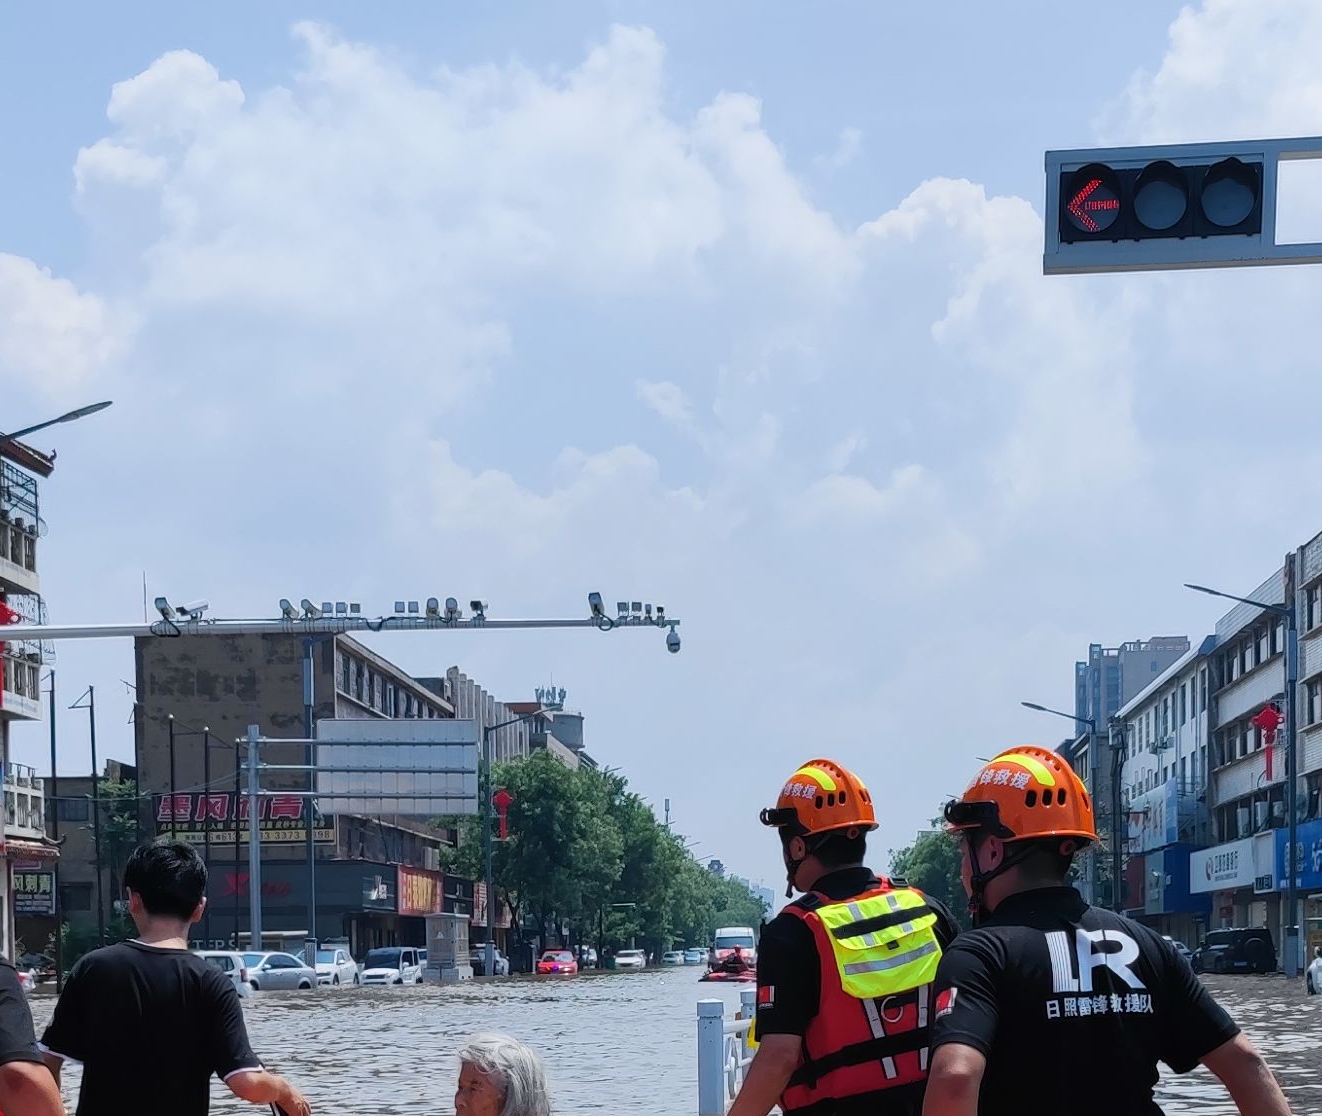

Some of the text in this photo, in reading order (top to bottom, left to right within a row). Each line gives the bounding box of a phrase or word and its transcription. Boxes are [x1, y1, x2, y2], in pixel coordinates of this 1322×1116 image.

[971, 768, 1031, 790] 锋救援
[1046, 993, 1154, 1019] 日照雷锋救援队
